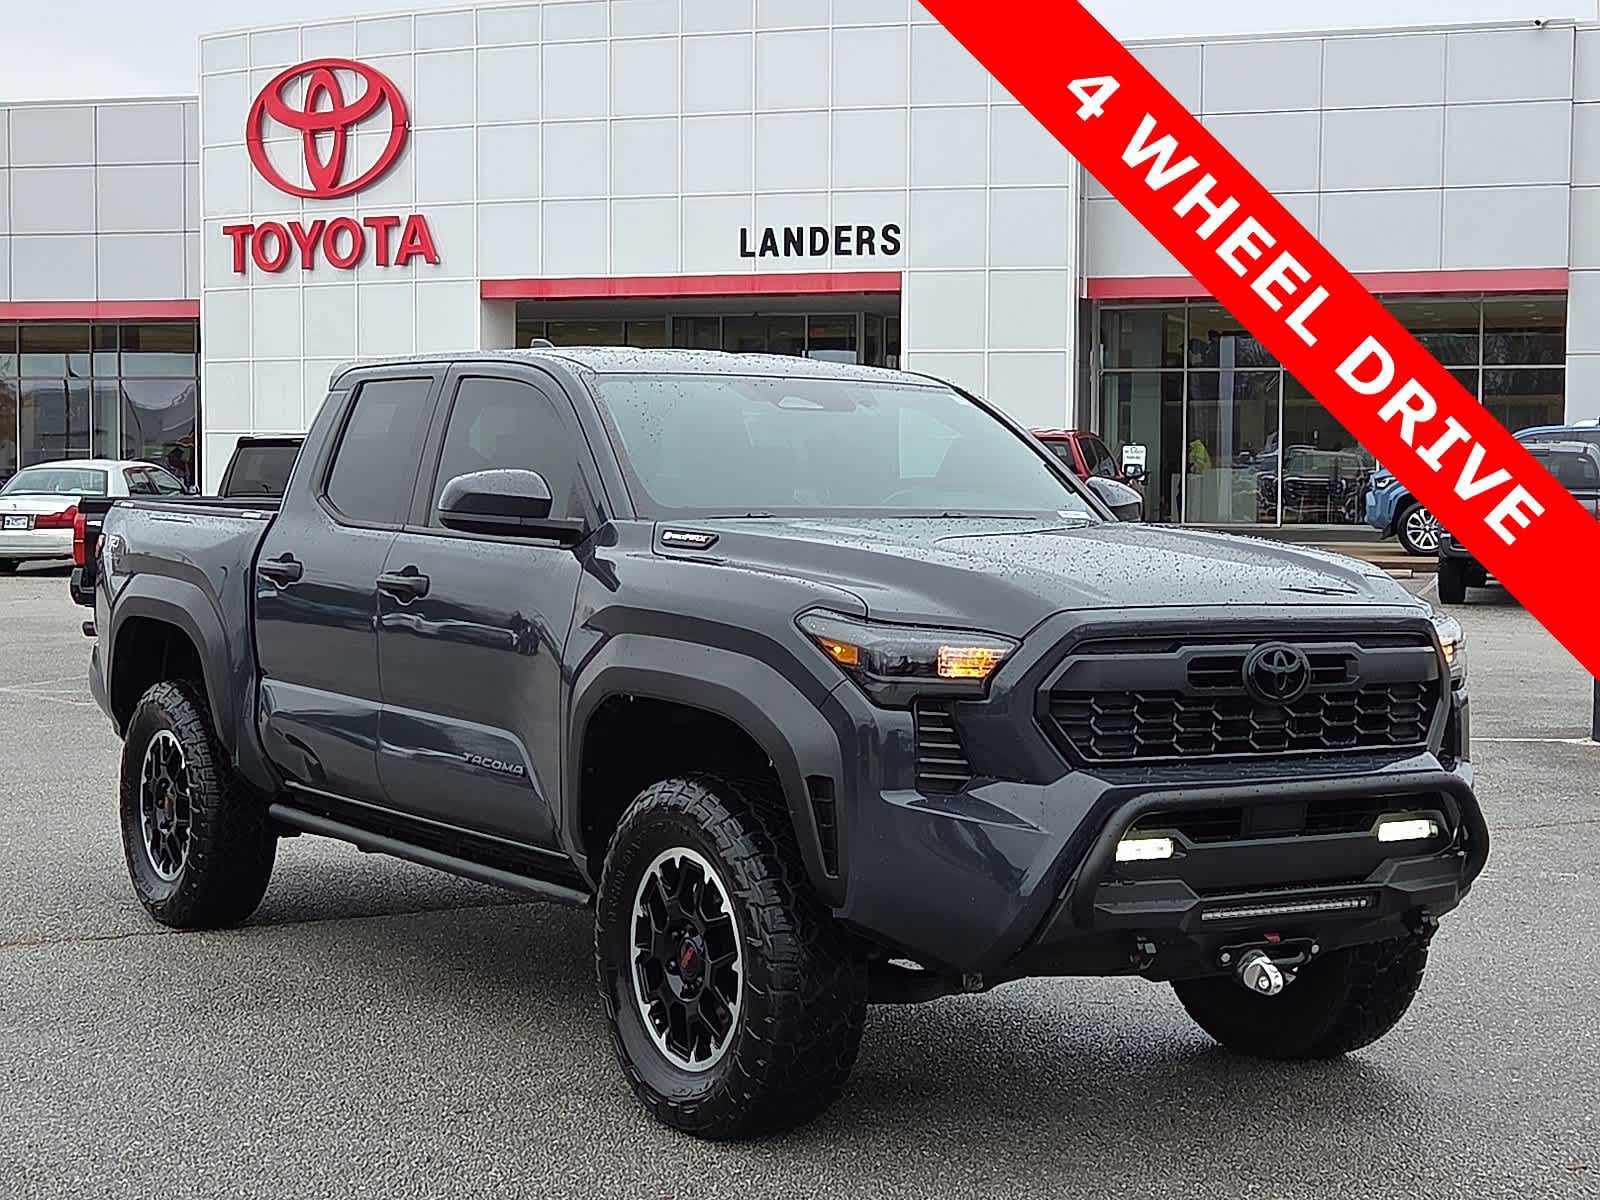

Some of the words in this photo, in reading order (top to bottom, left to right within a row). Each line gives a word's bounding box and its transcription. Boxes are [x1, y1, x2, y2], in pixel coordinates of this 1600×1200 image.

[222, 214, 439, 273] TOYOTA
[740, 224, 901, 257] LANDERS
[463, 752, 524, 775] TACOMA
